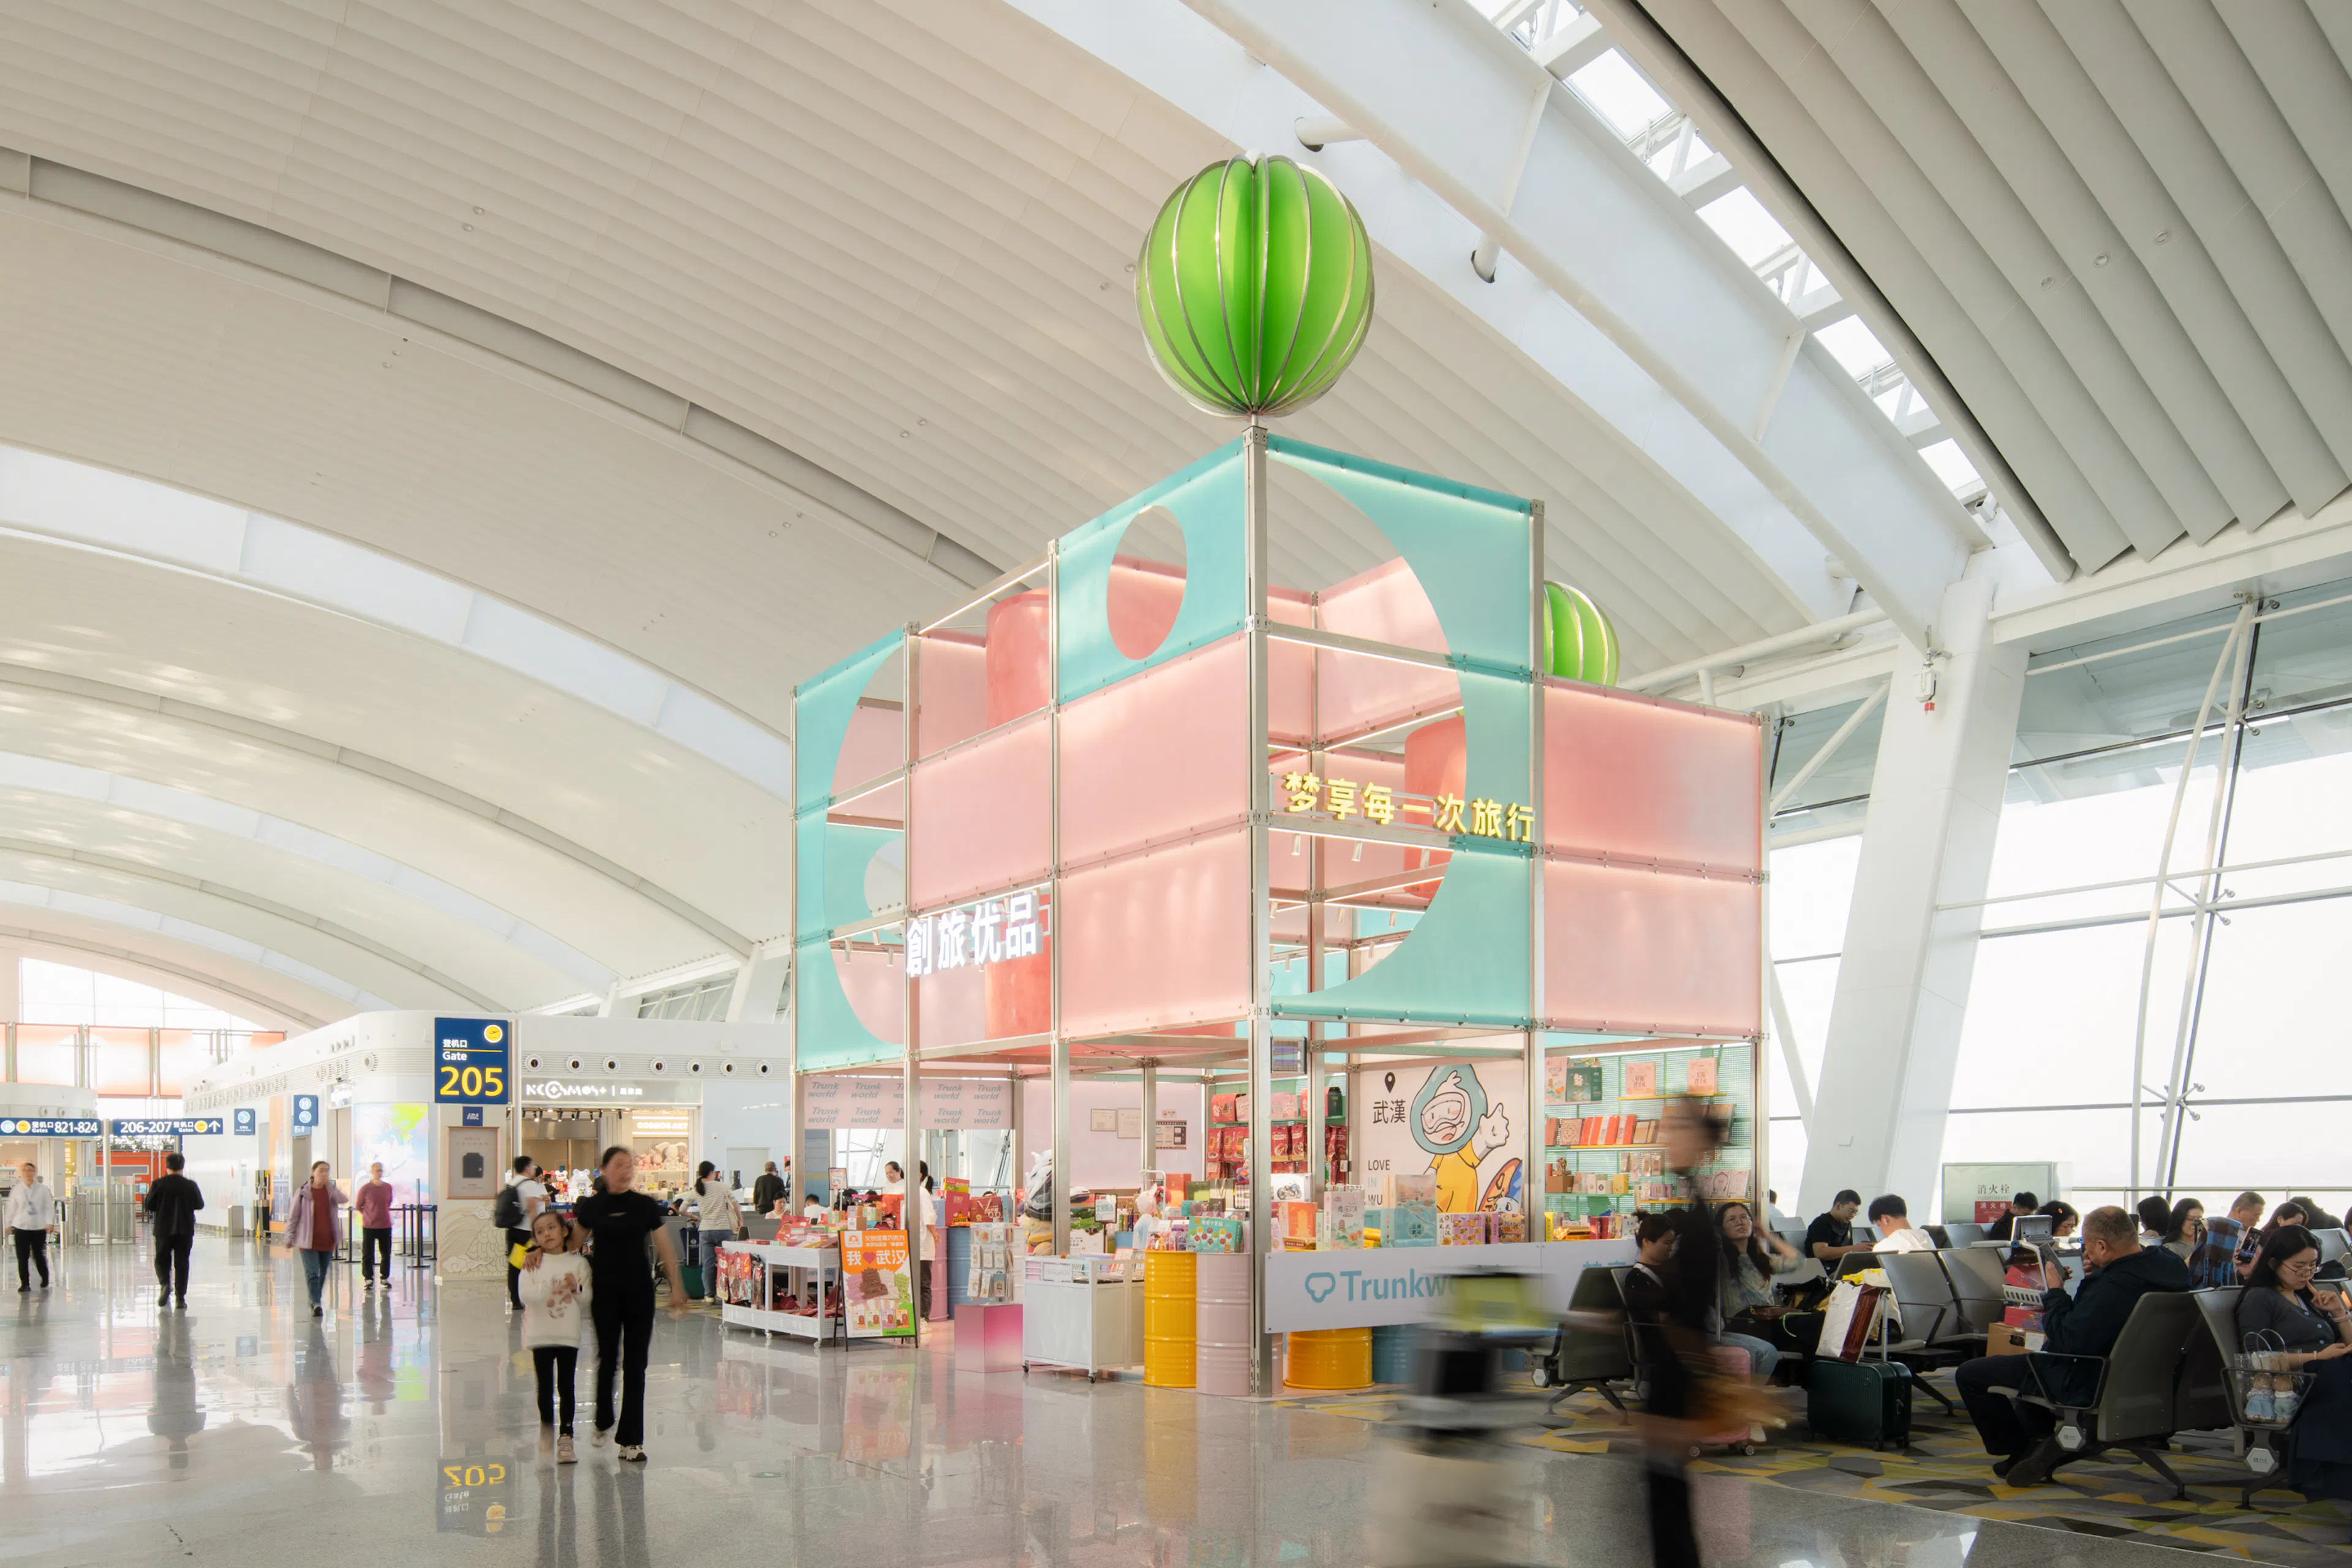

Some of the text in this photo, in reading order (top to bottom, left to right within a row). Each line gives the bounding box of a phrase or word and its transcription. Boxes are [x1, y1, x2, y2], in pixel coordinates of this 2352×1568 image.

[1283, 771, 1535, 842] 梦享每一次旅行
[906, 894, 1040, 978] 創旅优品
[443, 1039, 467, 1048] 登机口
[442, 1051, 467, 1060] Gate
[440, 1066, 503, 1096] 205
[812, 1107, 839, 1115] Trunk
[978, 1108, 1002, 1117] Trunk
[1373, 1099, 1406, 1124] 武漢
[55, 1121, 97, 1133] 821-824
[120, 1121, 172, 1133] 206-207
[1368, 1159, 1390, 1170] LOVE
[1368, 1177, 1377, 1187] IN
[1978, 1184, 2010, 1194] 消火栓
[846, 1250, 906, 1266] 我 武汉
